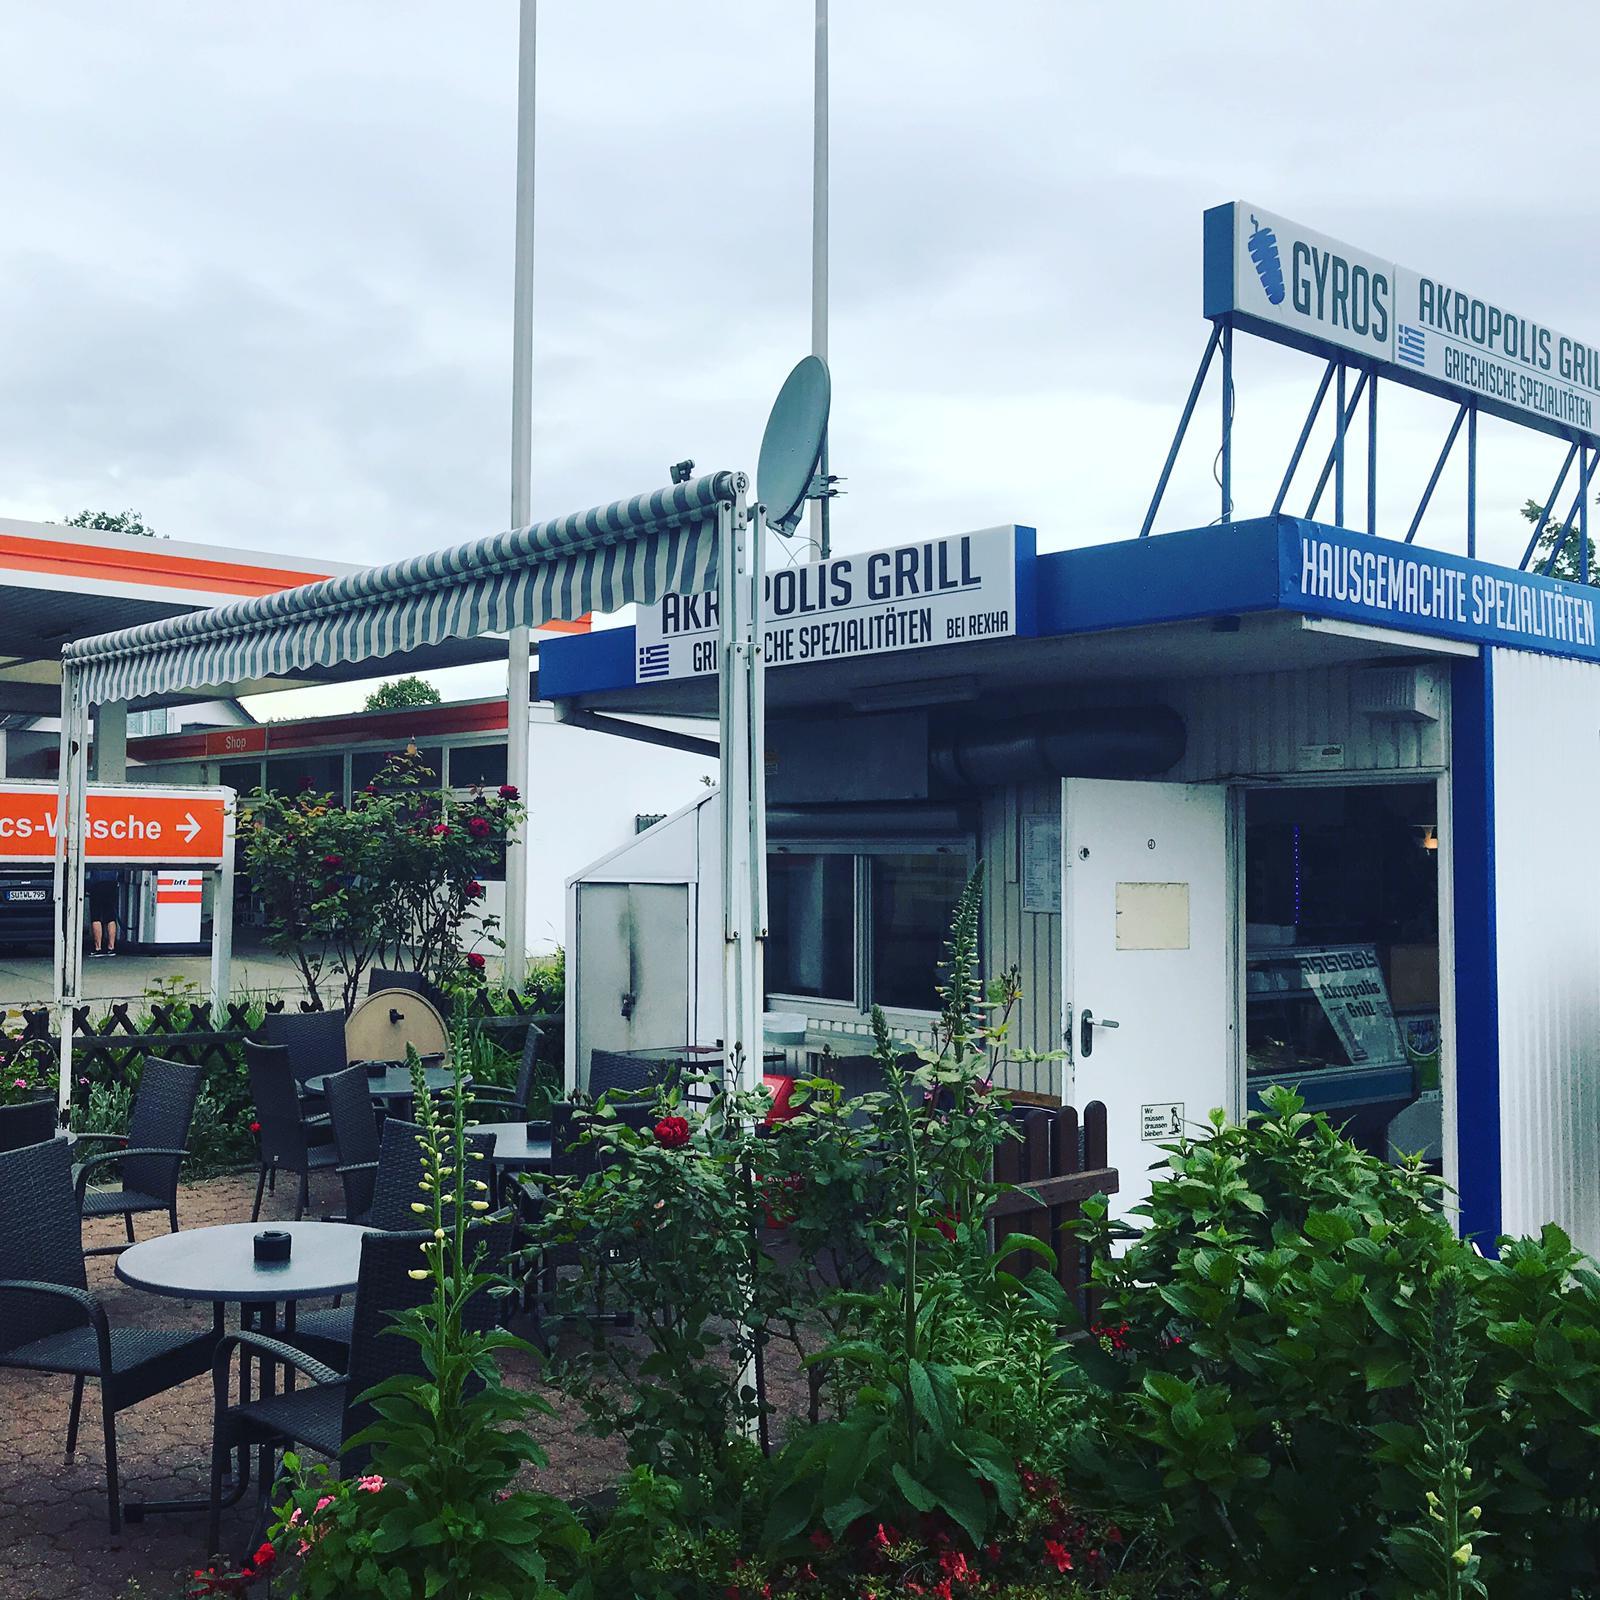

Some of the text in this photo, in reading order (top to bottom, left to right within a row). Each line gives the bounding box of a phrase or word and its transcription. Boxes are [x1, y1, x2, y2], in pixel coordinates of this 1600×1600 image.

[1292, 240, 1388, 343] GYROS
[1419, 278, 1551, 371] AKROPOLIS
[1444, 346, 1592, 429] GRIECHISCHE SPEZIALITÄTEN
[662, 536, 982, 634] AKROLIS GRILL
[1301, 538, 1596, 646] HAUSGEMACHTE SPEZIALITÄTEN
[799, 607, 932, 658] SPEZIALITÄTEN
[946, 621, 966, 639] BEI
[968, 610, 1009, 636] REXHA
[225, 735, 247, 752] Shop
[1319, 978, 1381, 1001] Akropolis
[1346, 1000, 1377, 1018] Grill
